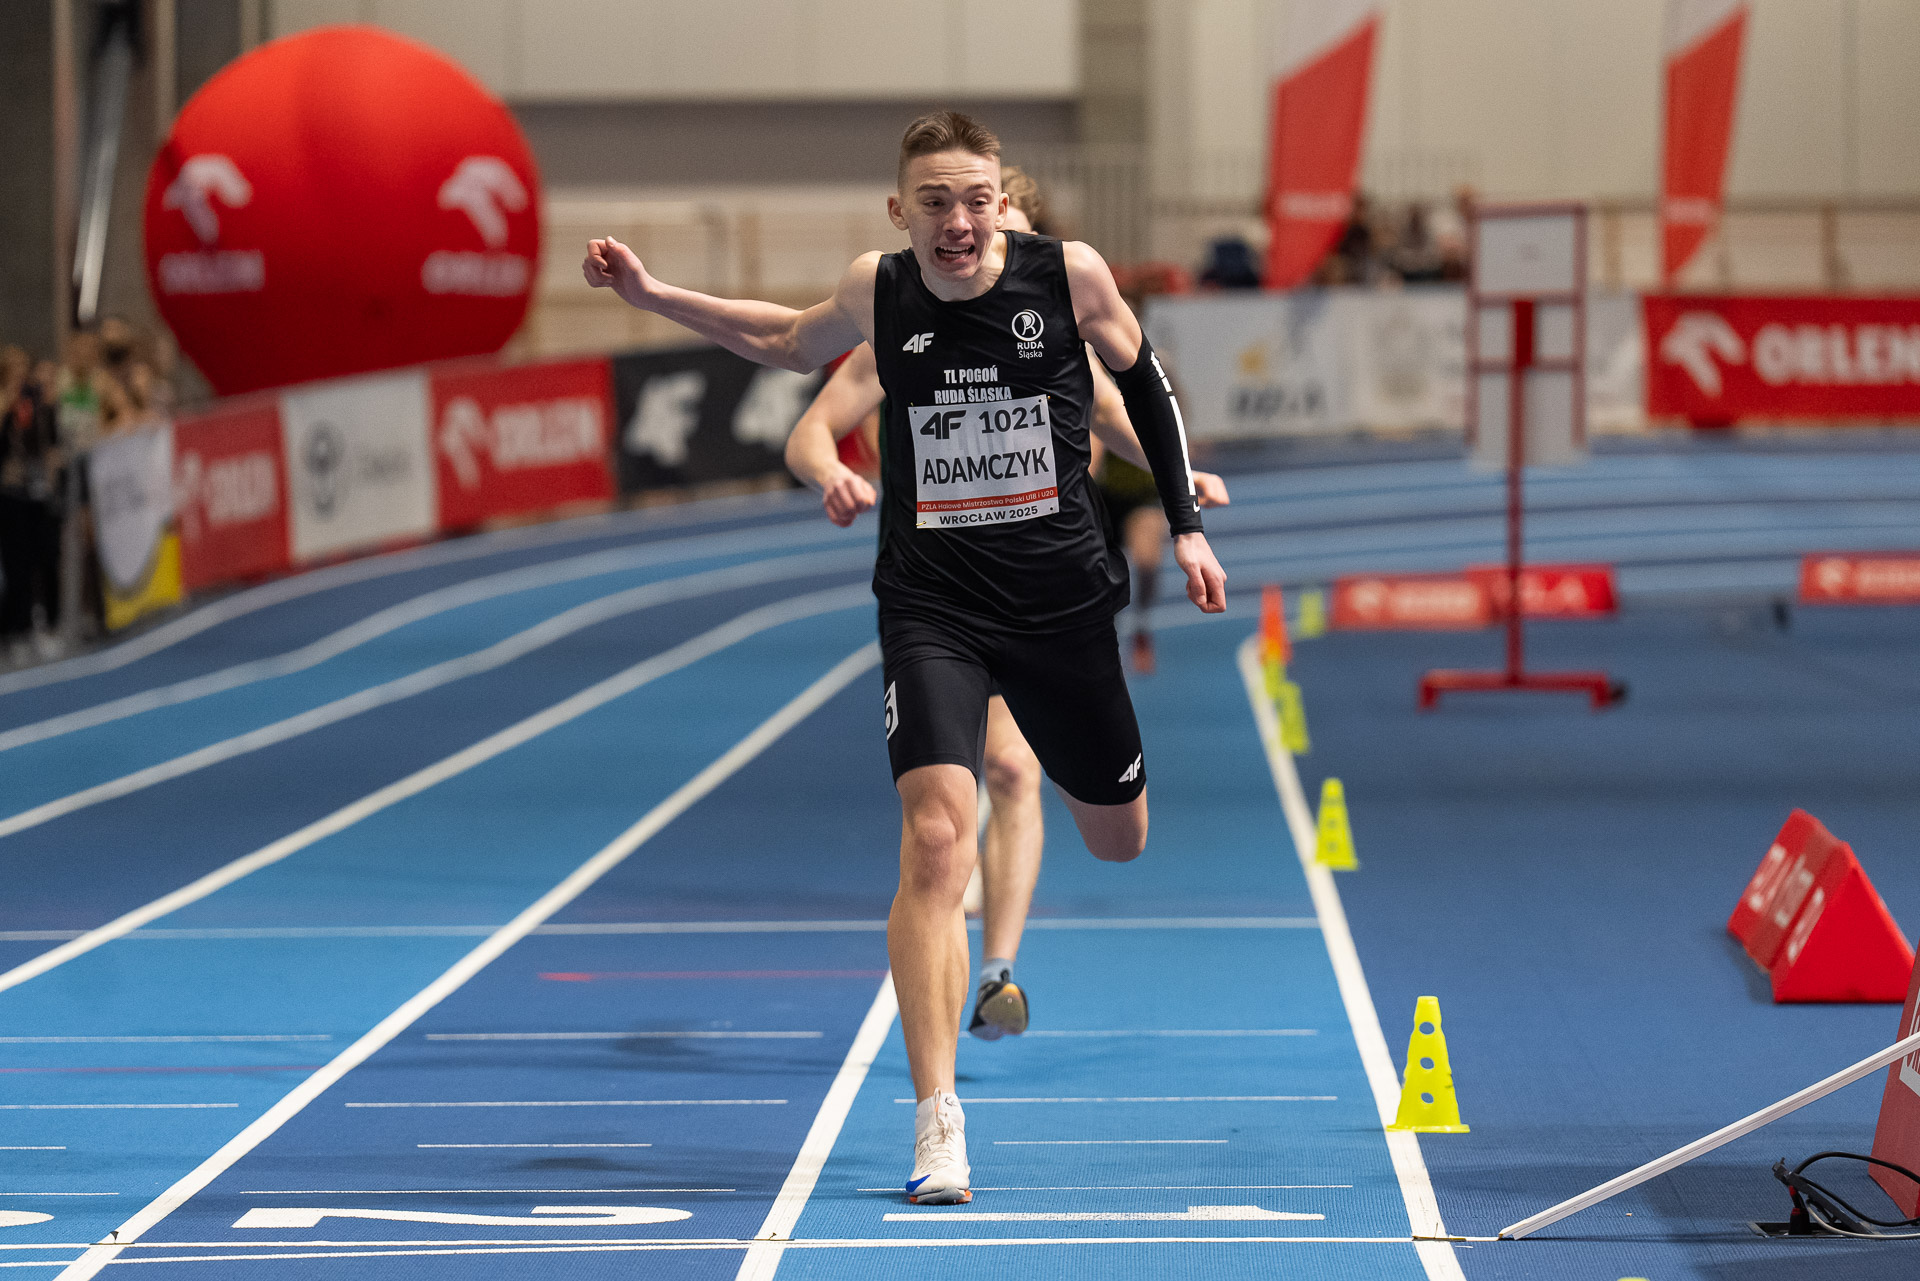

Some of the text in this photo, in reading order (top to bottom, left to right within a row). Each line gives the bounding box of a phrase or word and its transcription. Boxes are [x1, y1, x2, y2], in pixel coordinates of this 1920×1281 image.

[903, 332, 935, 353] 4F
[1017, 341, 1045, 350] RUDA
[1018, 350, 1043, 360] Śląska
[944, 365, 998, 384] TL POGOŃ
[934, 389, 966, 404] RUDA
[920, 404, 1046, 440] 4F 1021
[923, 447, 1049, 484] ADAMCZYK
[963, 499, 1003, 508] Mistrzostwa
[1026, 493, 1036, 501] U18
[1041, 490, 1054, 498] U20
[939, 505, 1038, 525] WROCŁAW 2025
